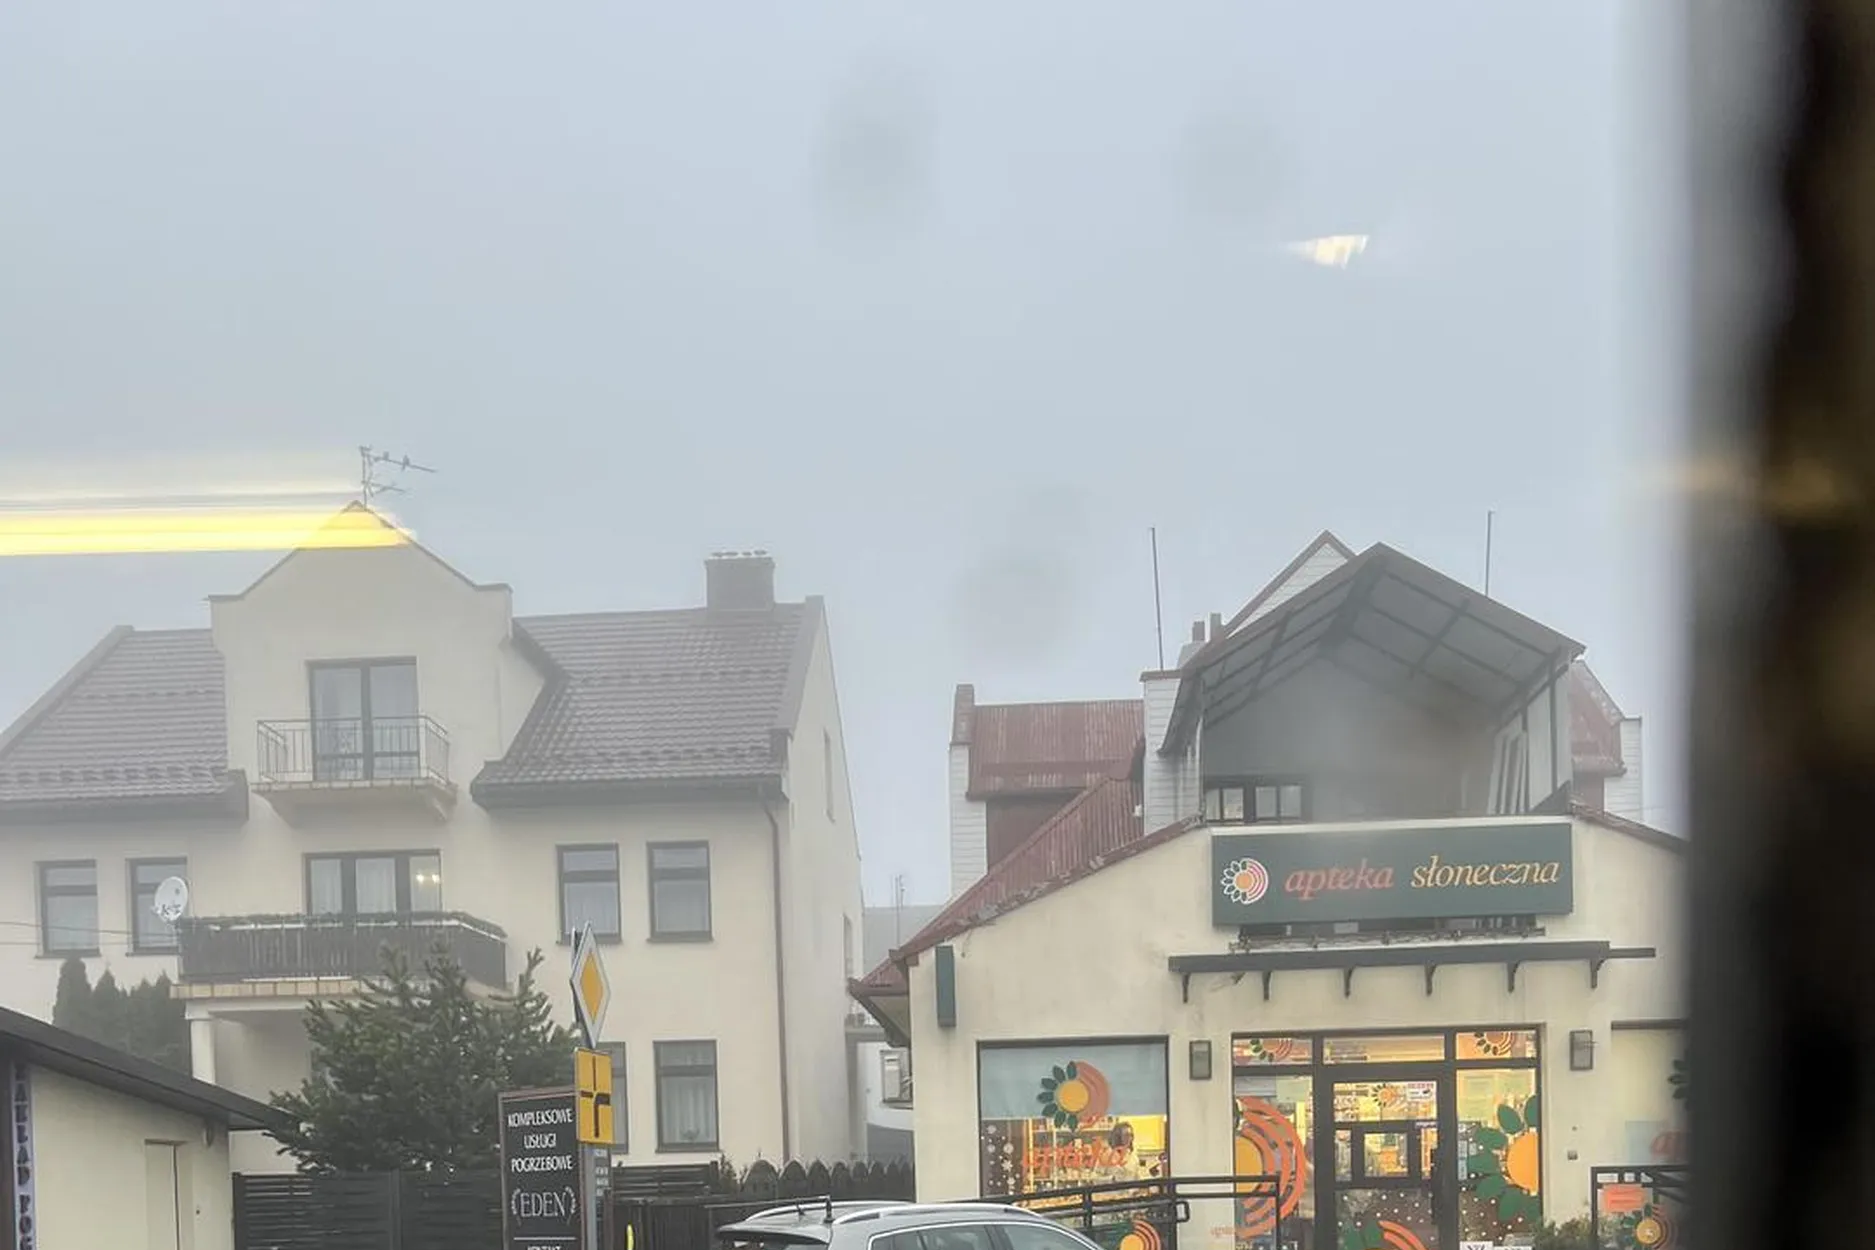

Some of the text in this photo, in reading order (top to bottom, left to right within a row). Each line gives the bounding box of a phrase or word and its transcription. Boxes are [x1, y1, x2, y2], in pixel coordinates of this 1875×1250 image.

[1284, 854, 1560, 901] apteka słoneczna
[508, 1108, 573, 1127] KOMPLEKSOWE
[524, 1133, 556, 1149] USŁUGI
[511, 1155, 573, 1172] POGRZEBOWE
[520, 1191, 566, 1217] EDEN
